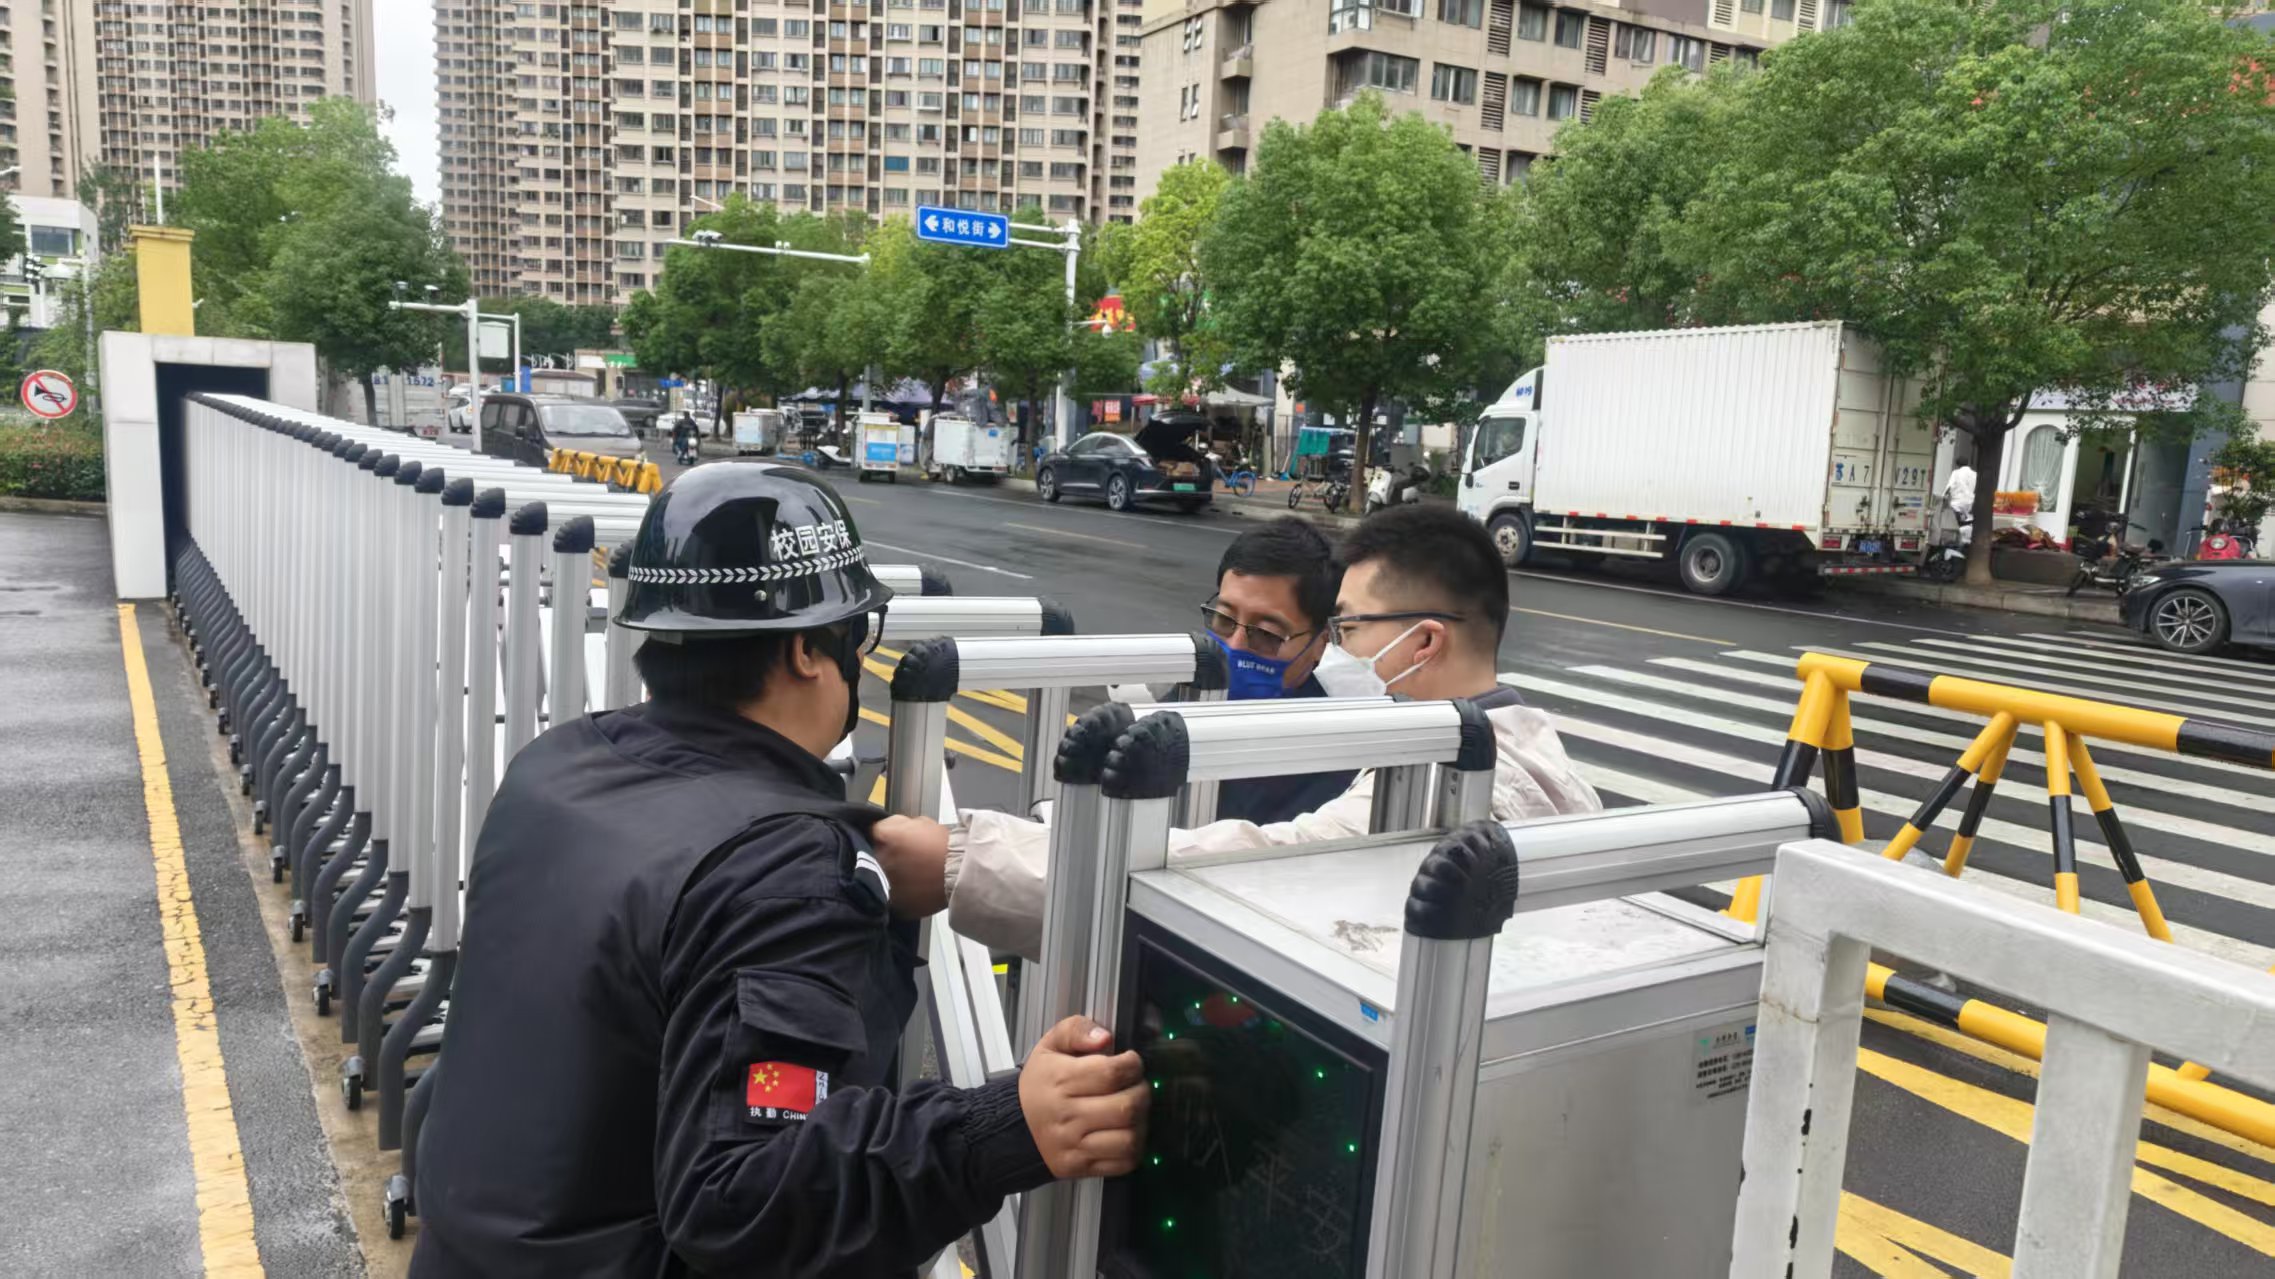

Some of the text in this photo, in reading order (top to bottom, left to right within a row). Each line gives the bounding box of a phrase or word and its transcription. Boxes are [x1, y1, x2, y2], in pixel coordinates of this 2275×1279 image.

[942, 217, 984, 237] 和悦街
[770, 519, 852, 561] 校园安保
[782, 1110, 808, 1121] CHIN
